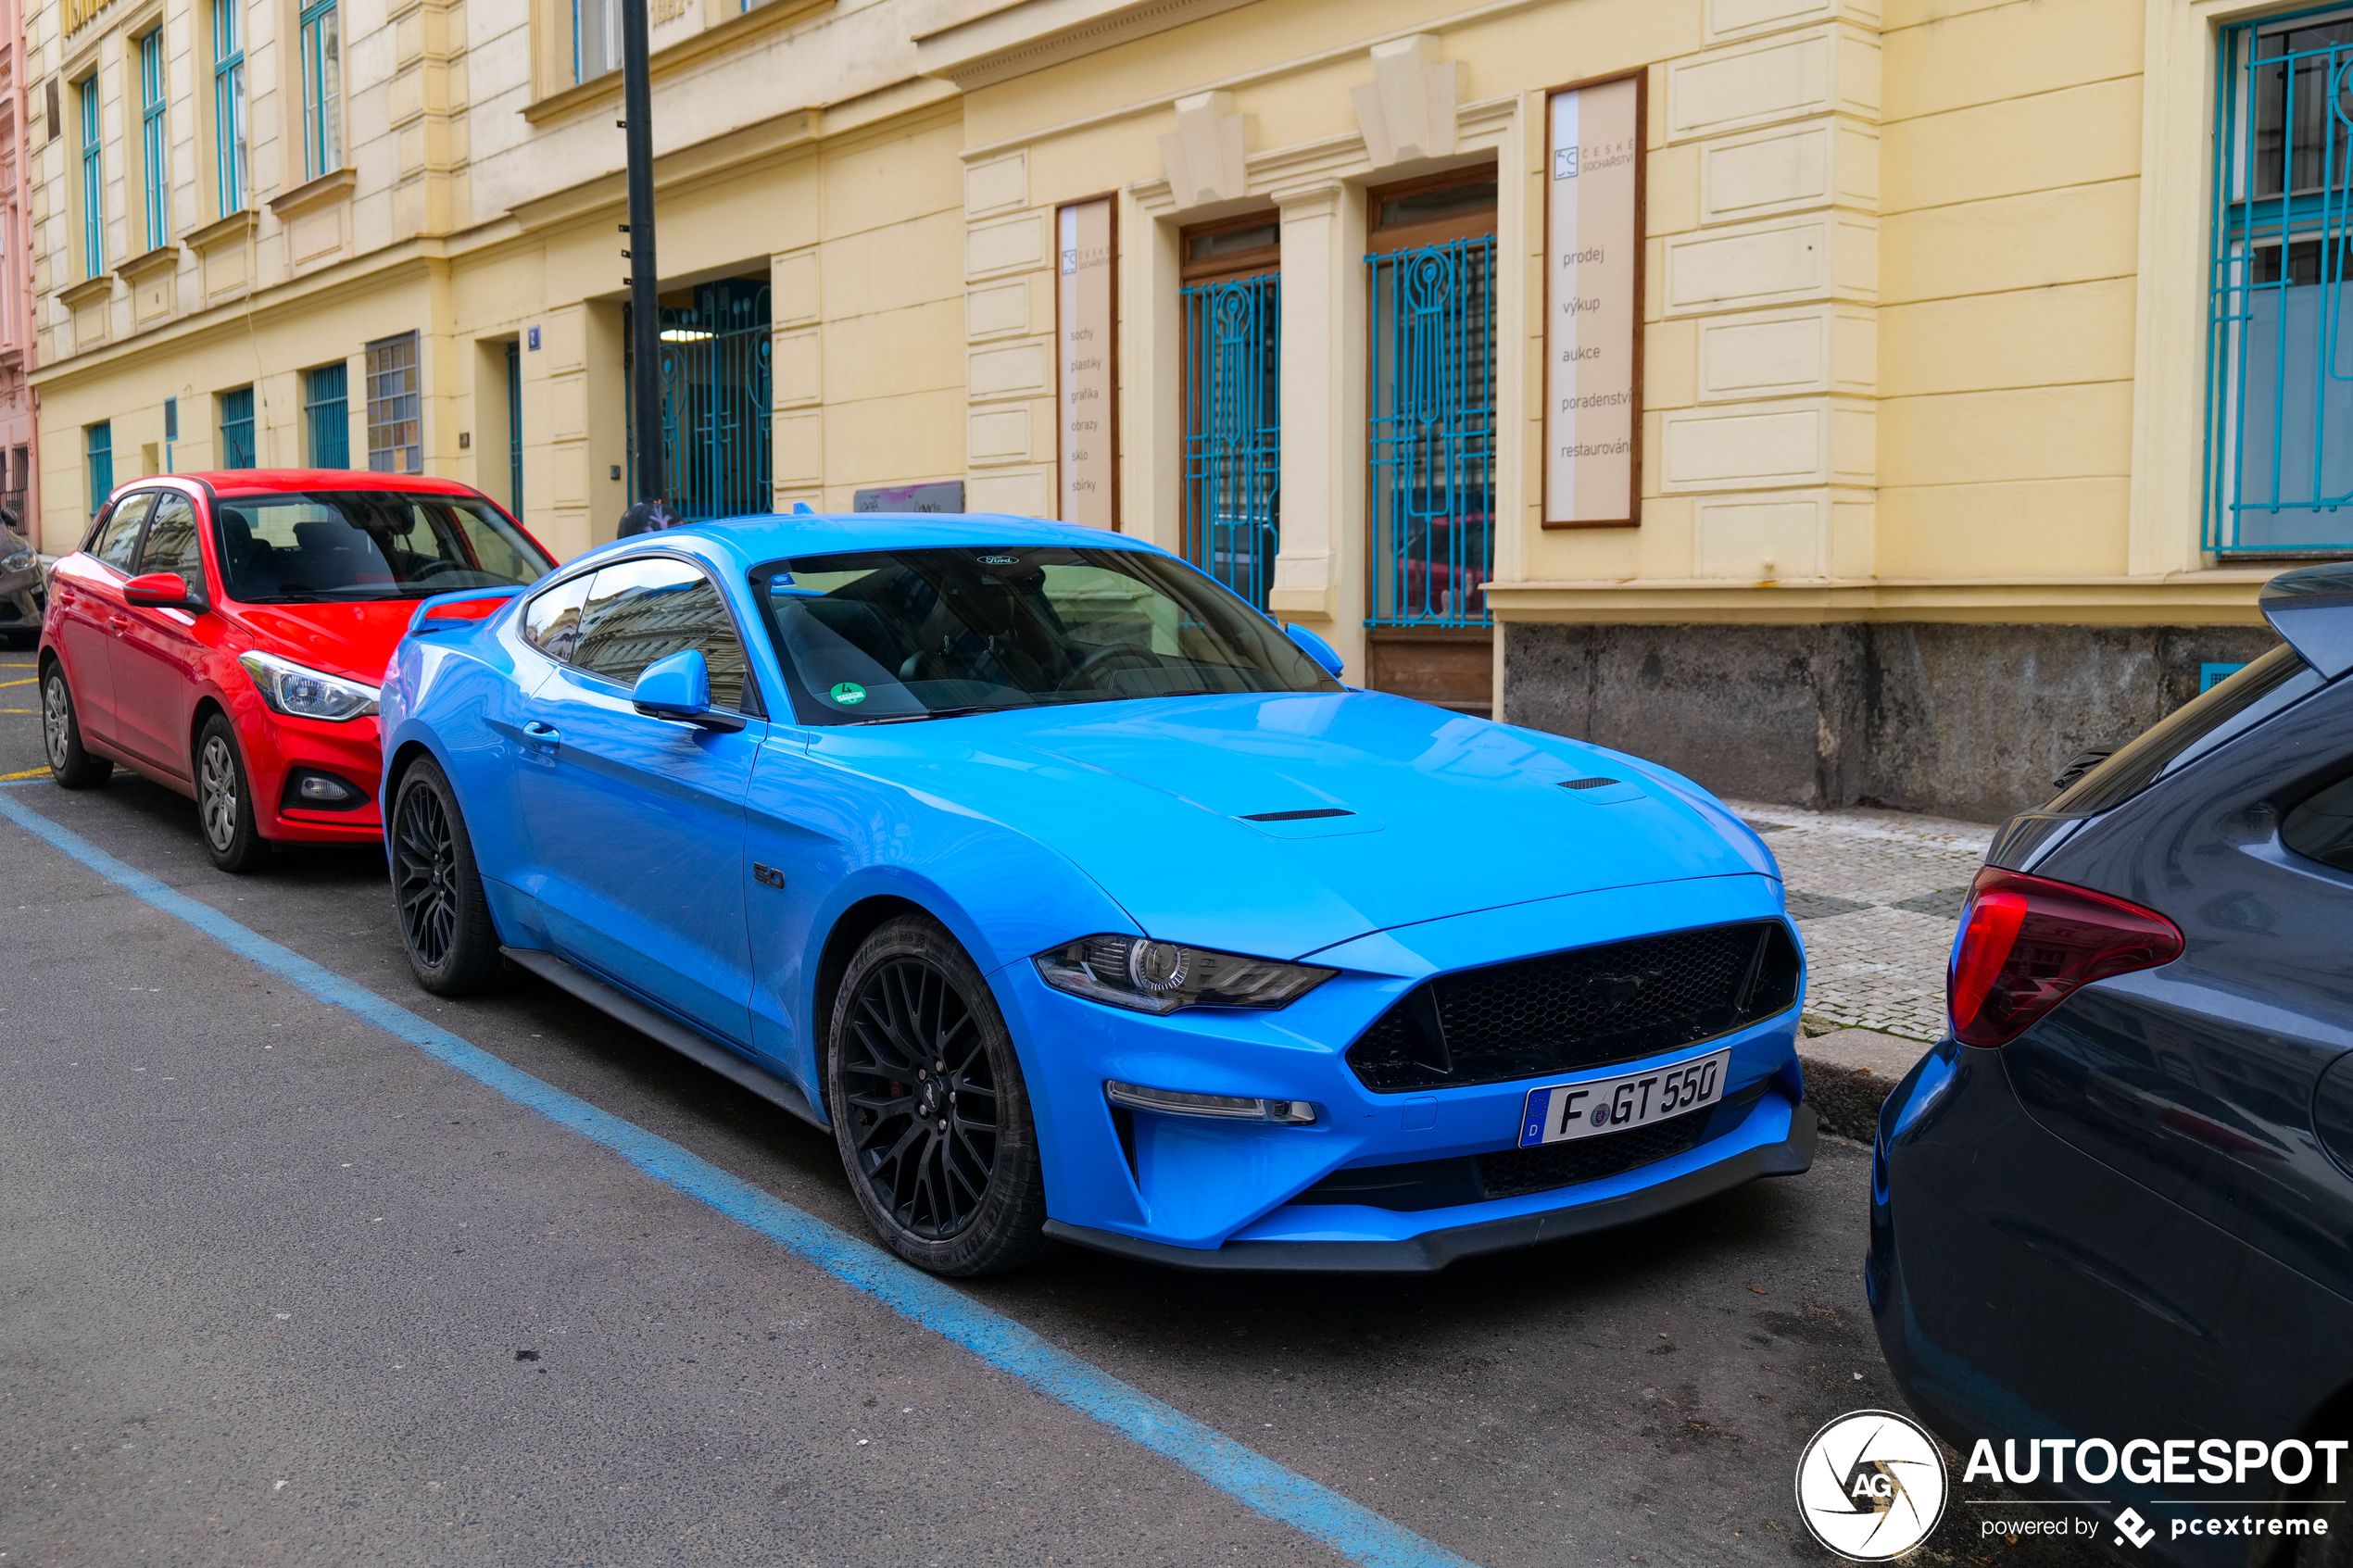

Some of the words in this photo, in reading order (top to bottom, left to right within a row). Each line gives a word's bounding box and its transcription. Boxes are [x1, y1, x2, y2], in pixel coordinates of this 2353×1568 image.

[1581, 137, 1634, 159] ČESKÉ
[1582, 151, 1634, 173] SOCHAŘSTVÍ
[1563, 245, 1604, 270] prodej
[1563, 296, 1601, 317] výkup
[1071, 327, 1094, 342] sochy
[1562, 346, 1601, 363] aukce
[1071, 357, 1101, 374] plastiky
[1071, 387, 1100, 405] grafika
[1562, 387, 1632, 414] poradenství
[1071, 419, 1099, 433] obrazy
[1072, 449, 1088, 462] sklo
[1072, 478, 1097, 494] sbírky
[985, 556, 1013, 564] Ford
[841, 683, 853, 694] 4
[1560, 1090, 1590, 1135] F
[1610, 1077, 1658, 1125] GT
[1661, 1060, 1718, 1113] 550
[1529, 1123, 1539, 1137] D
